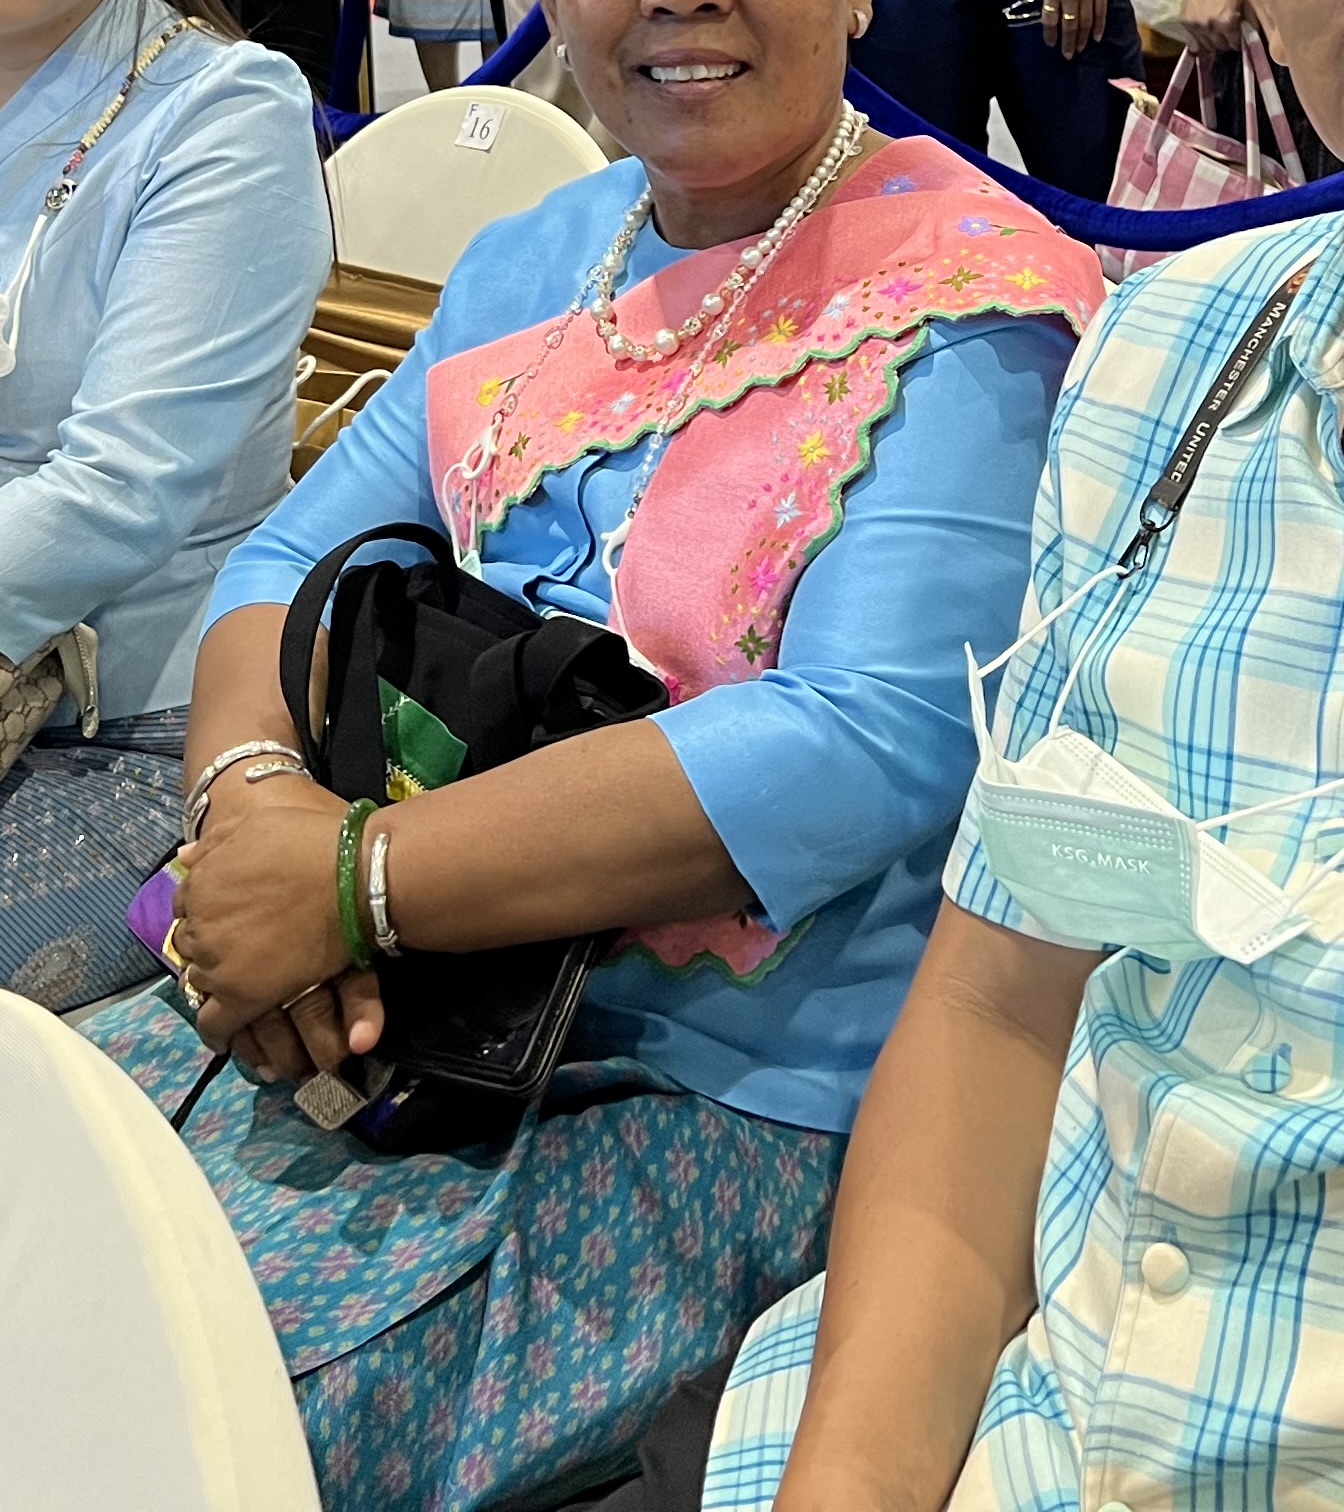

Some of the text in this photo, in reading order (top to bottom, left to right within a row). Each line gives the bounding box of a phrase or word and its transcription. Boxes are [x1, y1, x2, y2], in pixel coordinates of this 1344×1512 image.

[469, 116, 494, 140] 16
[1170, 301, 1288, 483] MANCHESTER UNITED
